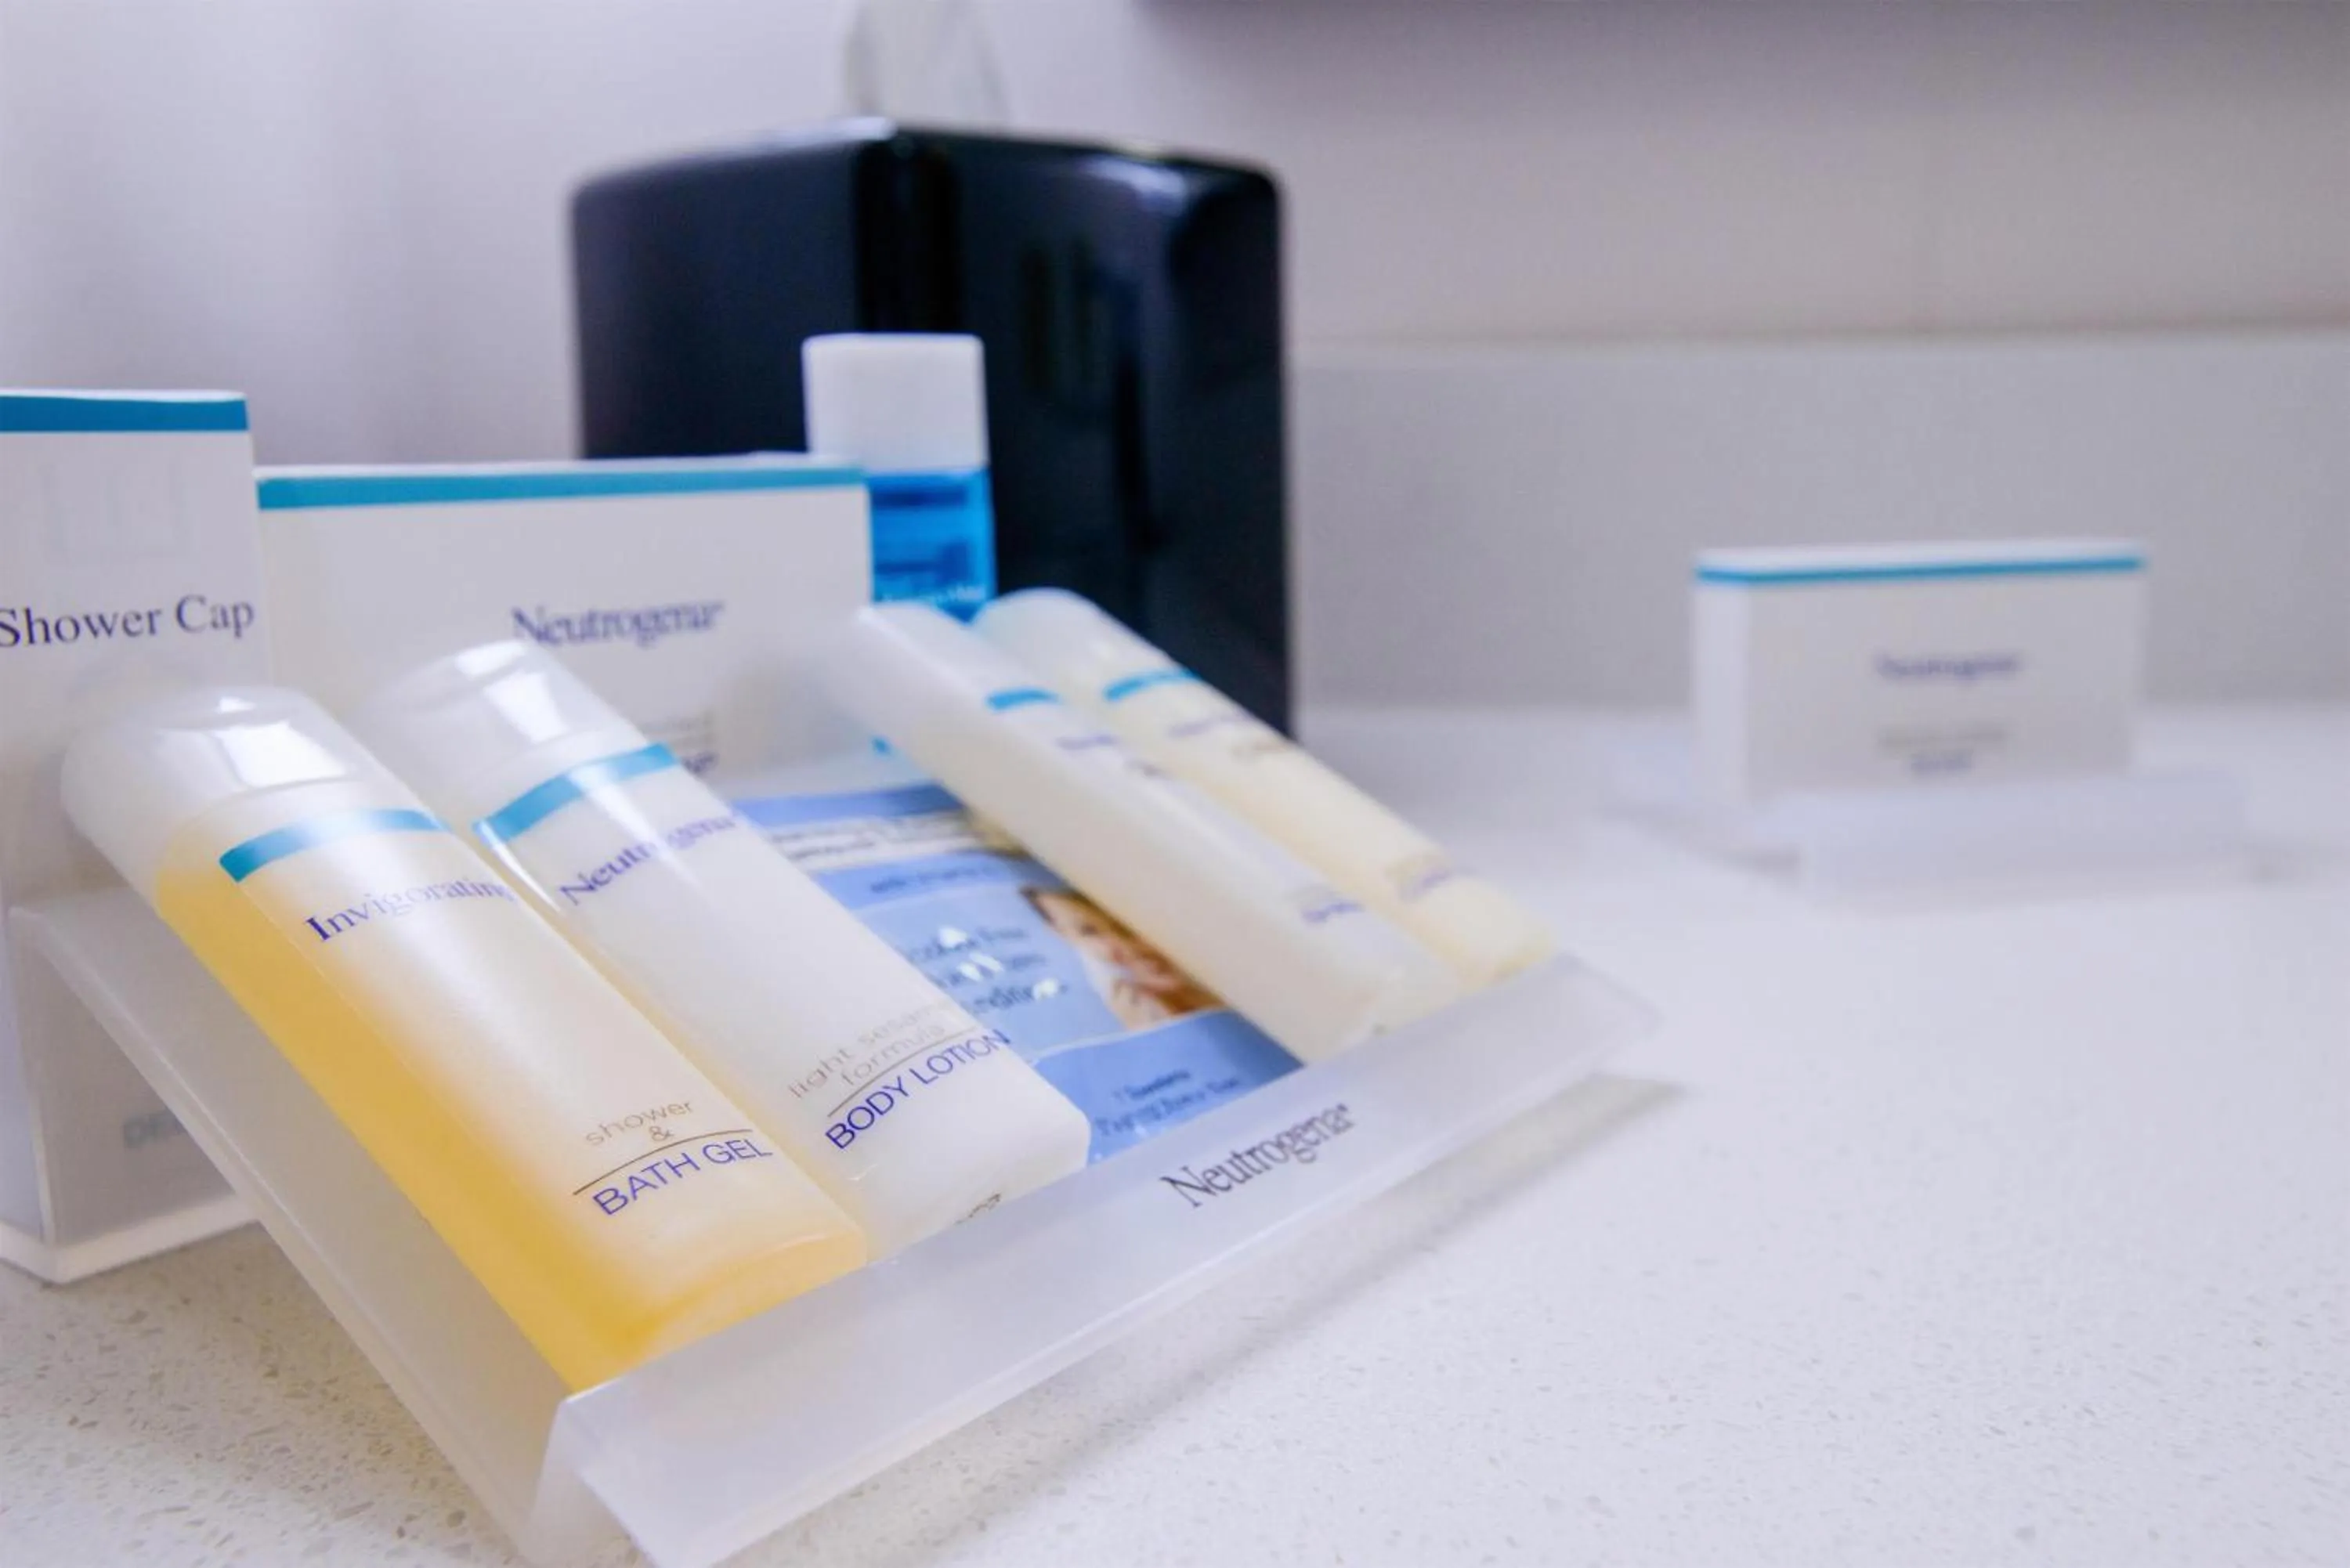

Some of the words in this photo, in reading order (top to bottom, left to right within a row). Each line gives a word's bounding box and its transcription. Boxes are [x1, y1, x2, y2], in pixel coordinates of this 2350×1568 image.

[0, 606, 163, 649] Shower
[175, 593, 256, 638] Cap
[786, 1047, 854, 1099] light
[824, 1075, 909, 1150] BODY
[909, 1027, 1011, 1086] LOTION
[586, 1099, 694, 1147] shower
[649, 1124, 674, 1142] &
[592, 1151, 701, 1216] BATH
[702, 1138, 773, 1166] GEL
